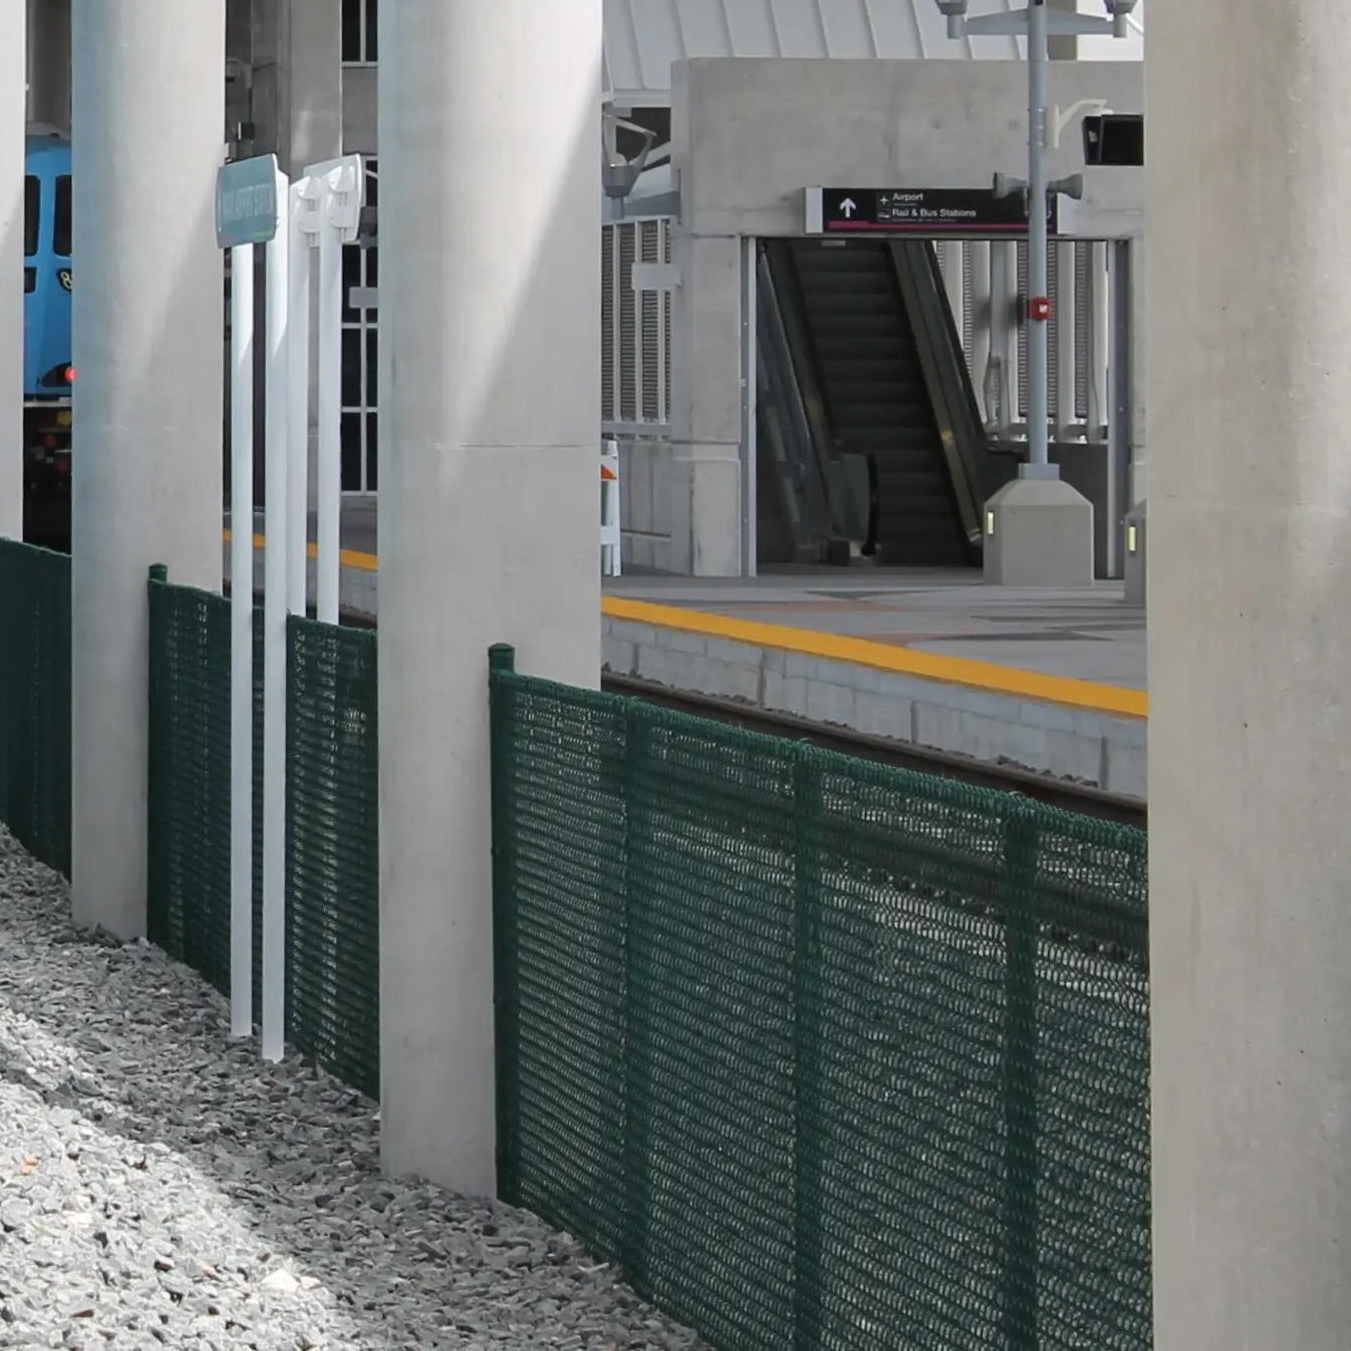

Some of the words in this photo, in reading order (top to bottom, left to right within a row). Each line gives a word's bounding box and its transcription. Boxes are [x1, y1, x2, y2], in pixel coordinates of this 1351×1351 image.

[892, 193, 923, 202] Airport
[892, 209, 909, 217] Rail
[911, 209, 918, 217] &
[920, 209, 938, 217] Bus
[940, 209, 976, 218] Stations
